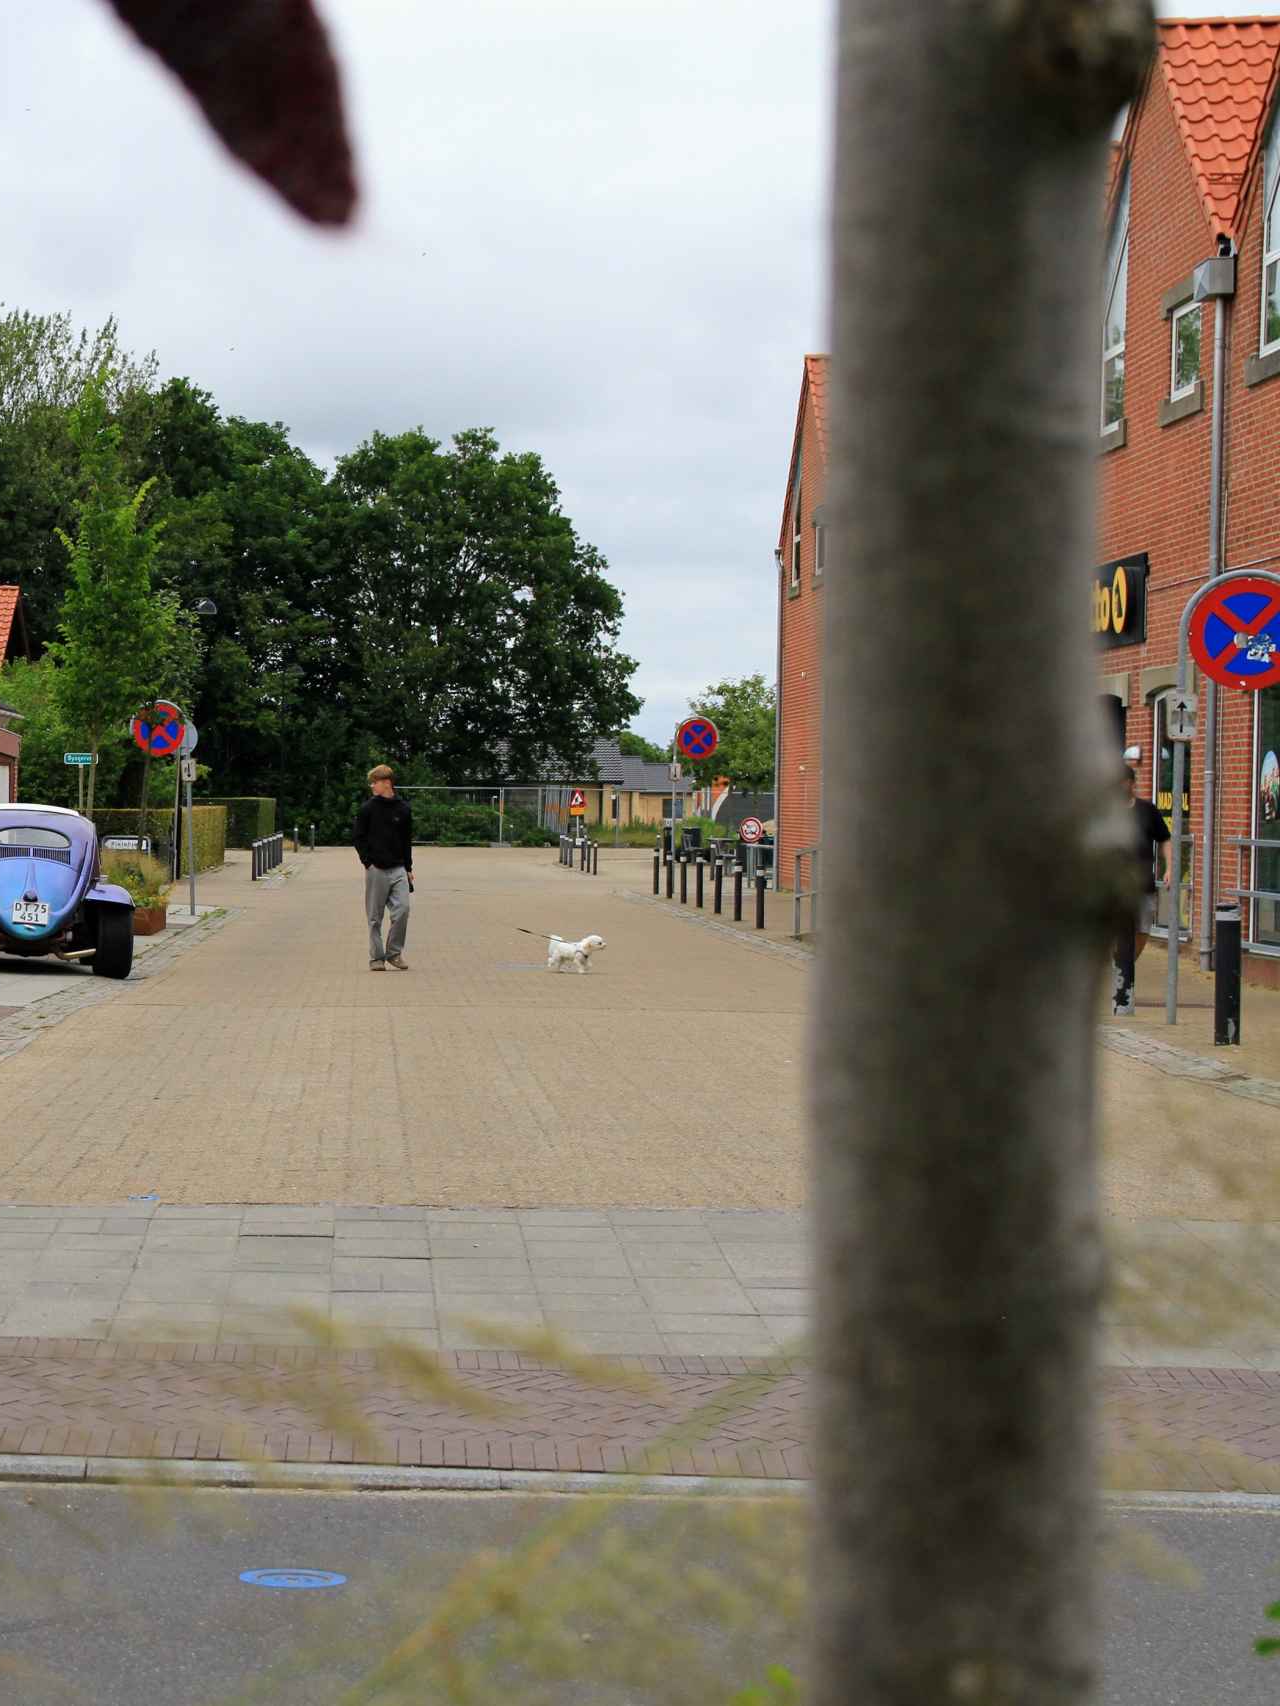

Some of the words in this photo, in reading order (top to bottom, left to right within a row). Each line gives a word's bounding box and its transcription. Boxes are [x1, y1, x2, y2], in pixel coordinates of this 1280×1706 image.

[15, 902, 31, 912] DT
[34, 903, 47, 914] 75
[20, 912, 40, 922] 451
